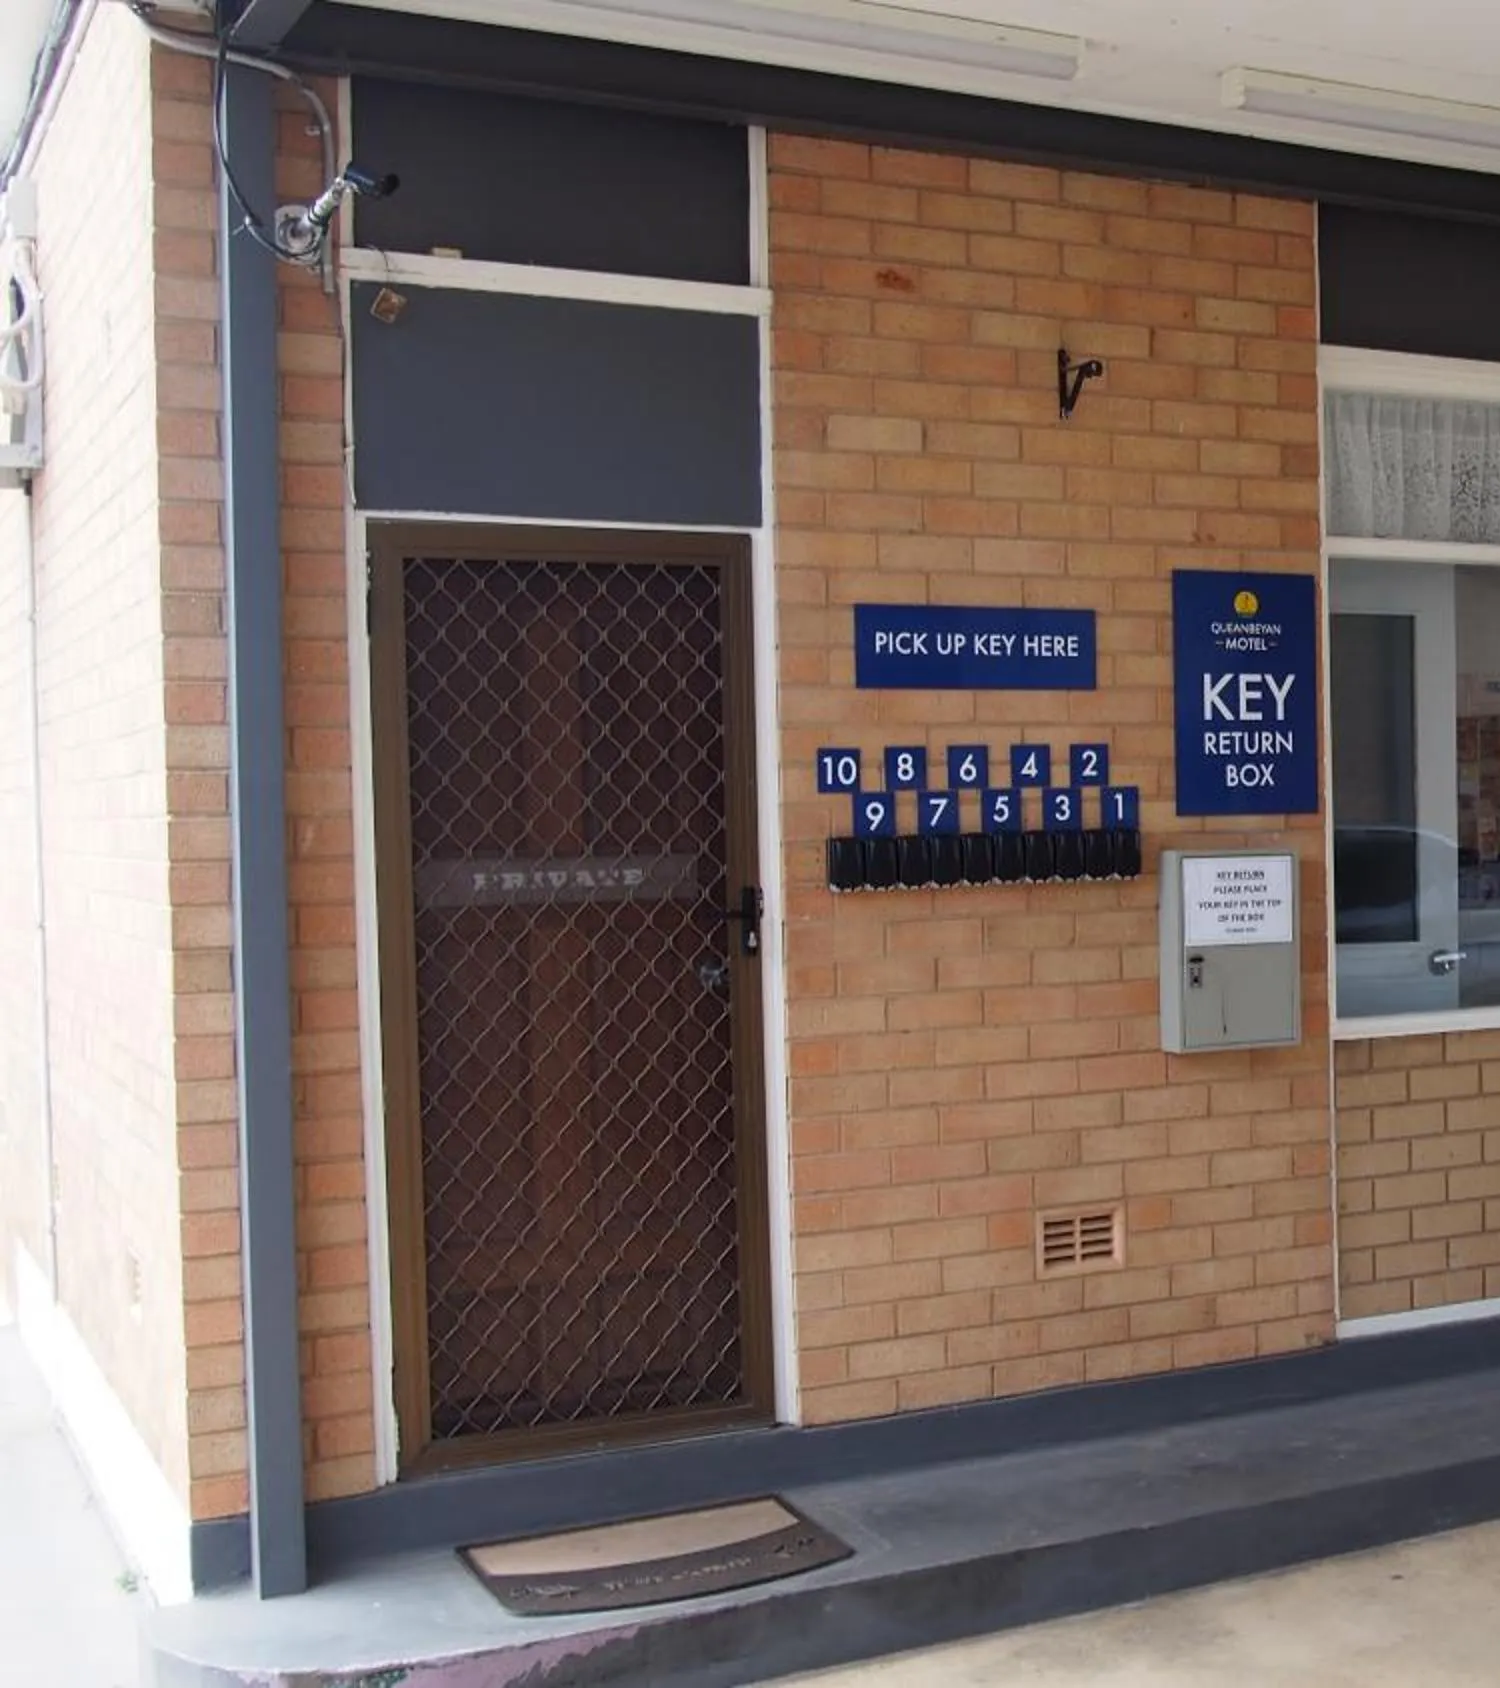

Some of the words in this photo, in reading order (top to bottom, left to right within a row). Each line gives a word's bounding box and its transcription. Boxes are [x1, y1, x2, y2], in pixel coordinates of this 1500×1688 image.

[1211, 622, 1281, 635] QUEANBEYAN
[874, 631, 929, 655] PICK
[936, 633, 965, 655] UP
[973, 634, 1016, 656] KEY
[1023, 636, 1079, 657] HERE
[1225, 638, 1267, 651] MOTEL
[1203, 673, 1296, 721] KEY
[1204, 731, 1293, 755] RETURN
[823, 756, 857, 785] 10
[897, 752, 915, 781] 8
[959, 754, 977, 782] 6
[1021, 752, 1038, 778] 4
[1082, 750, 1098, 777] 2
[1226, 764, 1275, 786] BOX
[865, 801, 885, 831] 9
[929, 798, 948, 827] 7
[993, 796, 1009, 822] 5
[1055, 795, 1071, 821] 3
[1113, 793, 1123, 820] 1
